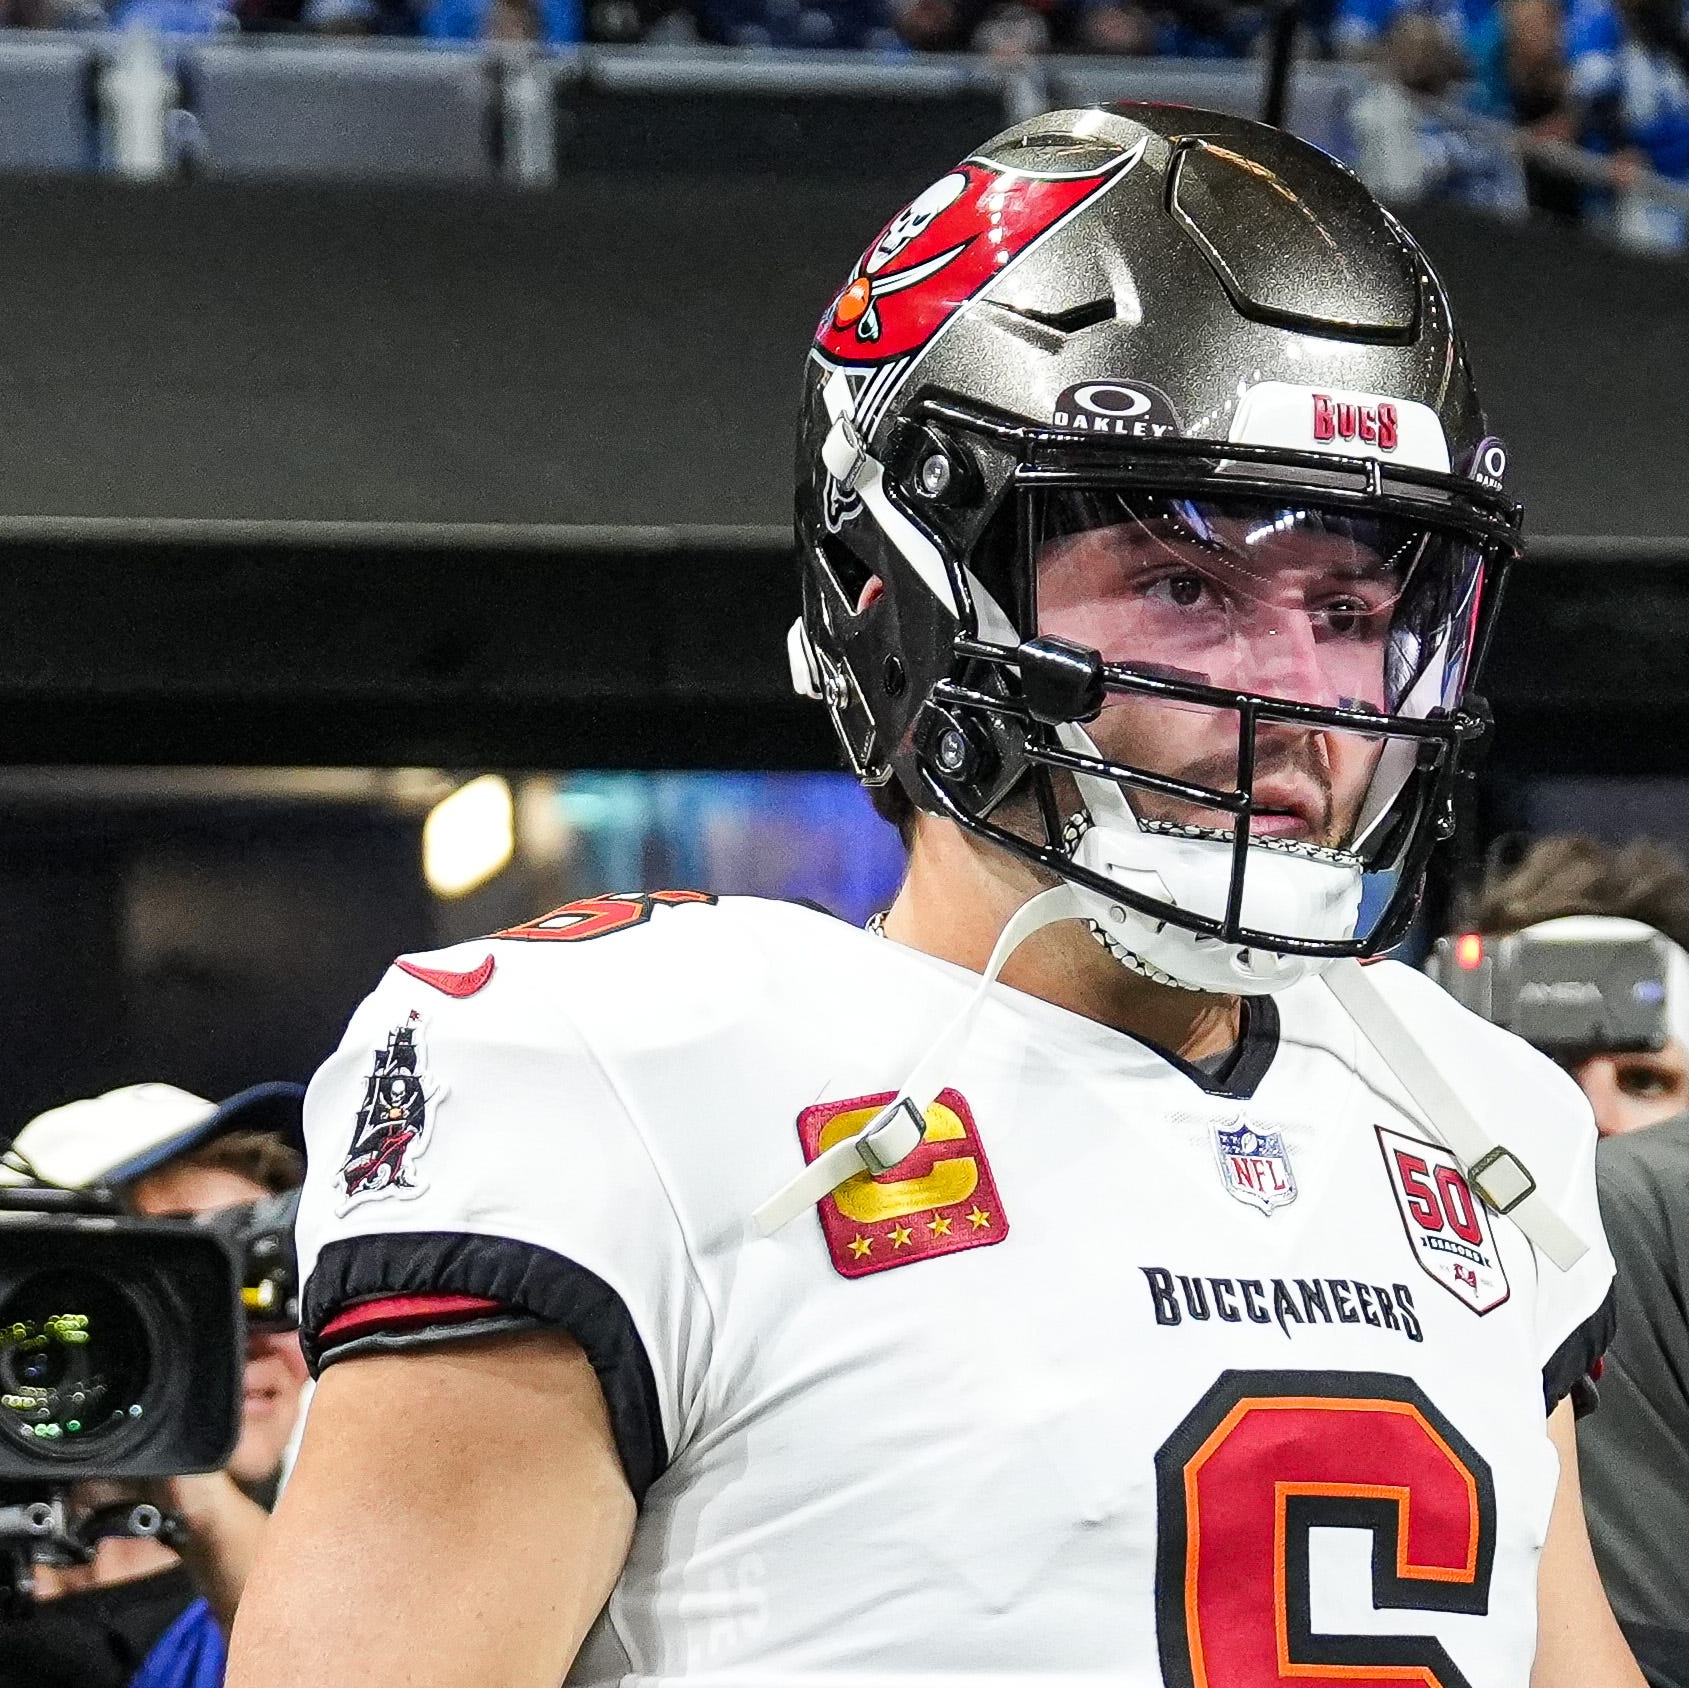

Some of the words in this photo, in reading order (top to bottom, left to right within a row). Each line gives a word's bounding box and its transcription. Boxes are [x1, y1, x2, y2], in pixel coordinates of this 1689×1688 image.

[1054, 411, 1168, 437] OAKLEY
[1230, 1157, 1286, 1193] NFL
[1393, 1148, 1483, 1247] 50
[1429, 1237, 1481, 1262] SEASONS
[1139, 1265, 1423, 1343] BUCCANEERS
